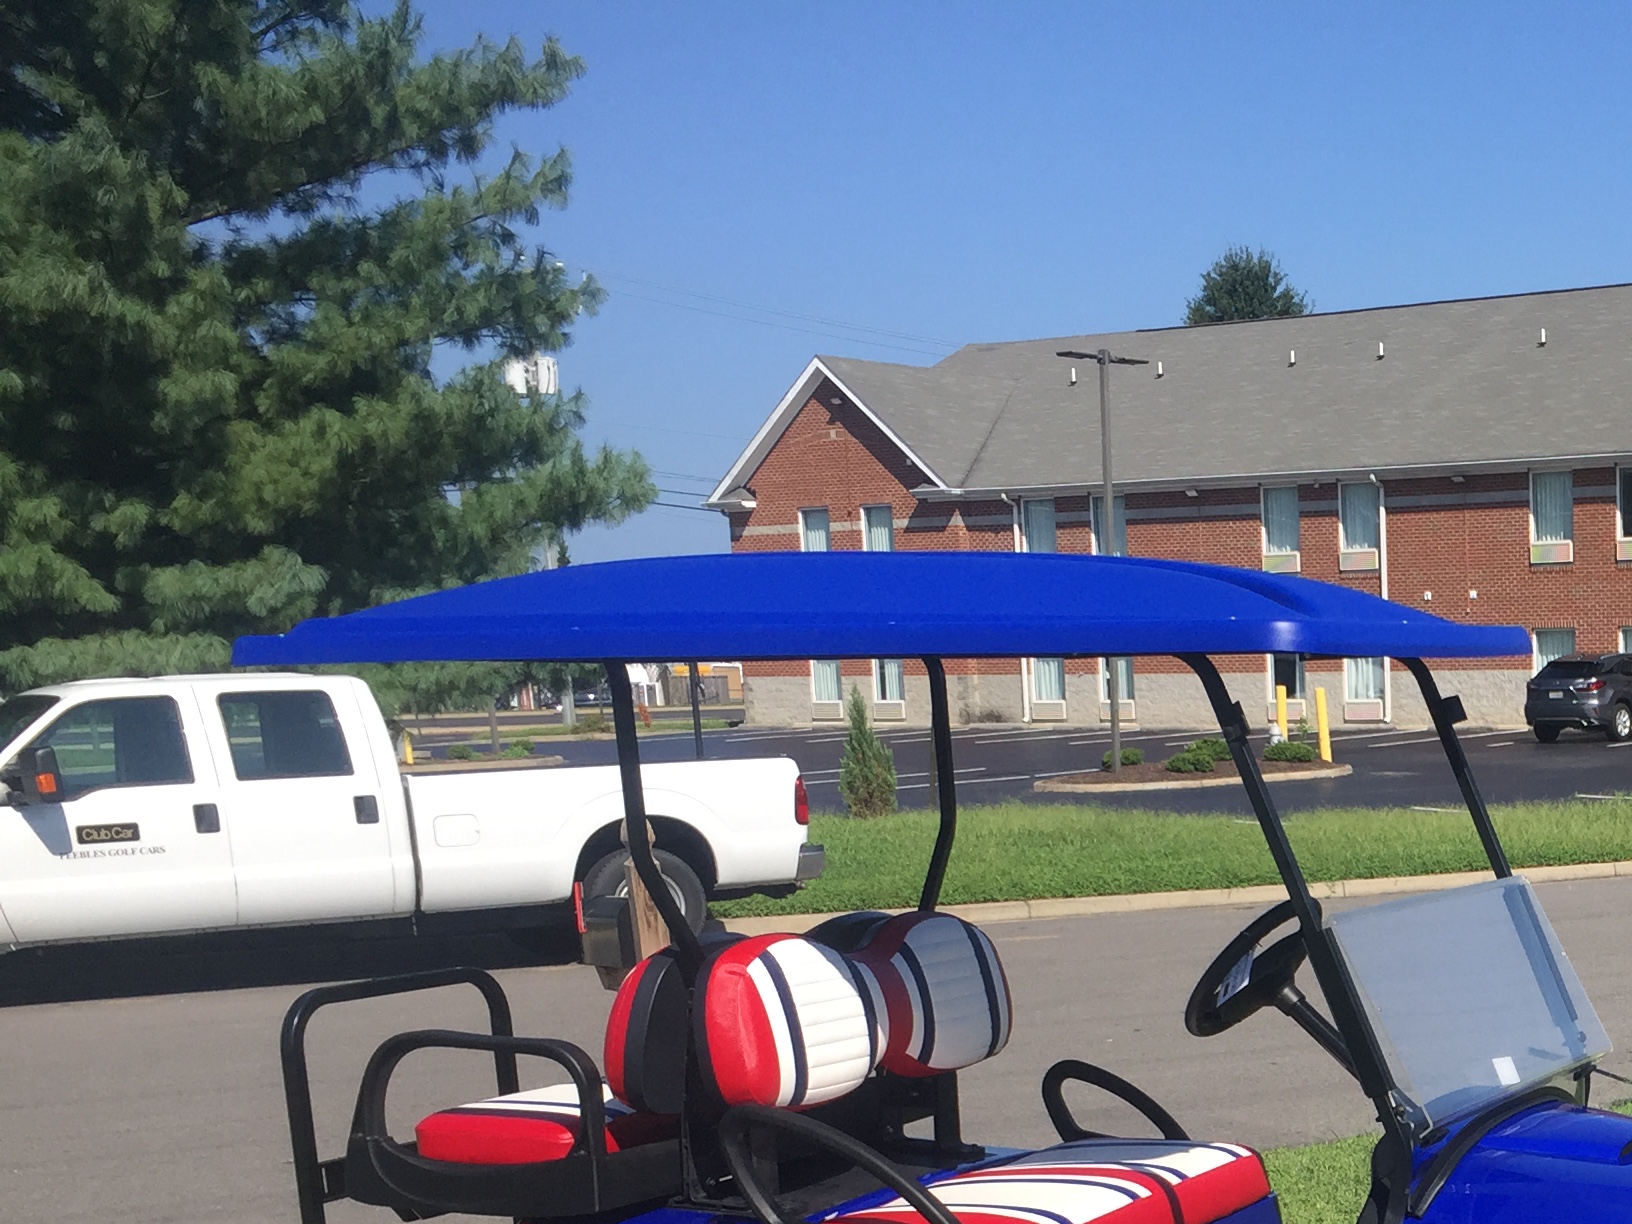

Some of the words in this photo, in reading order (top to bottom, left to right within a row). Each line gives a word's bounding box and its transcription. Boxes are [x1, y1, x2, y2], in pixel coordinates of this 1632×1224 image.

[82, 828, 111, 841] Club
[112, 827, 133, 839] Car
[108, 848, 138, 857] GOLF
[139, 846, 166, 855] CARS
